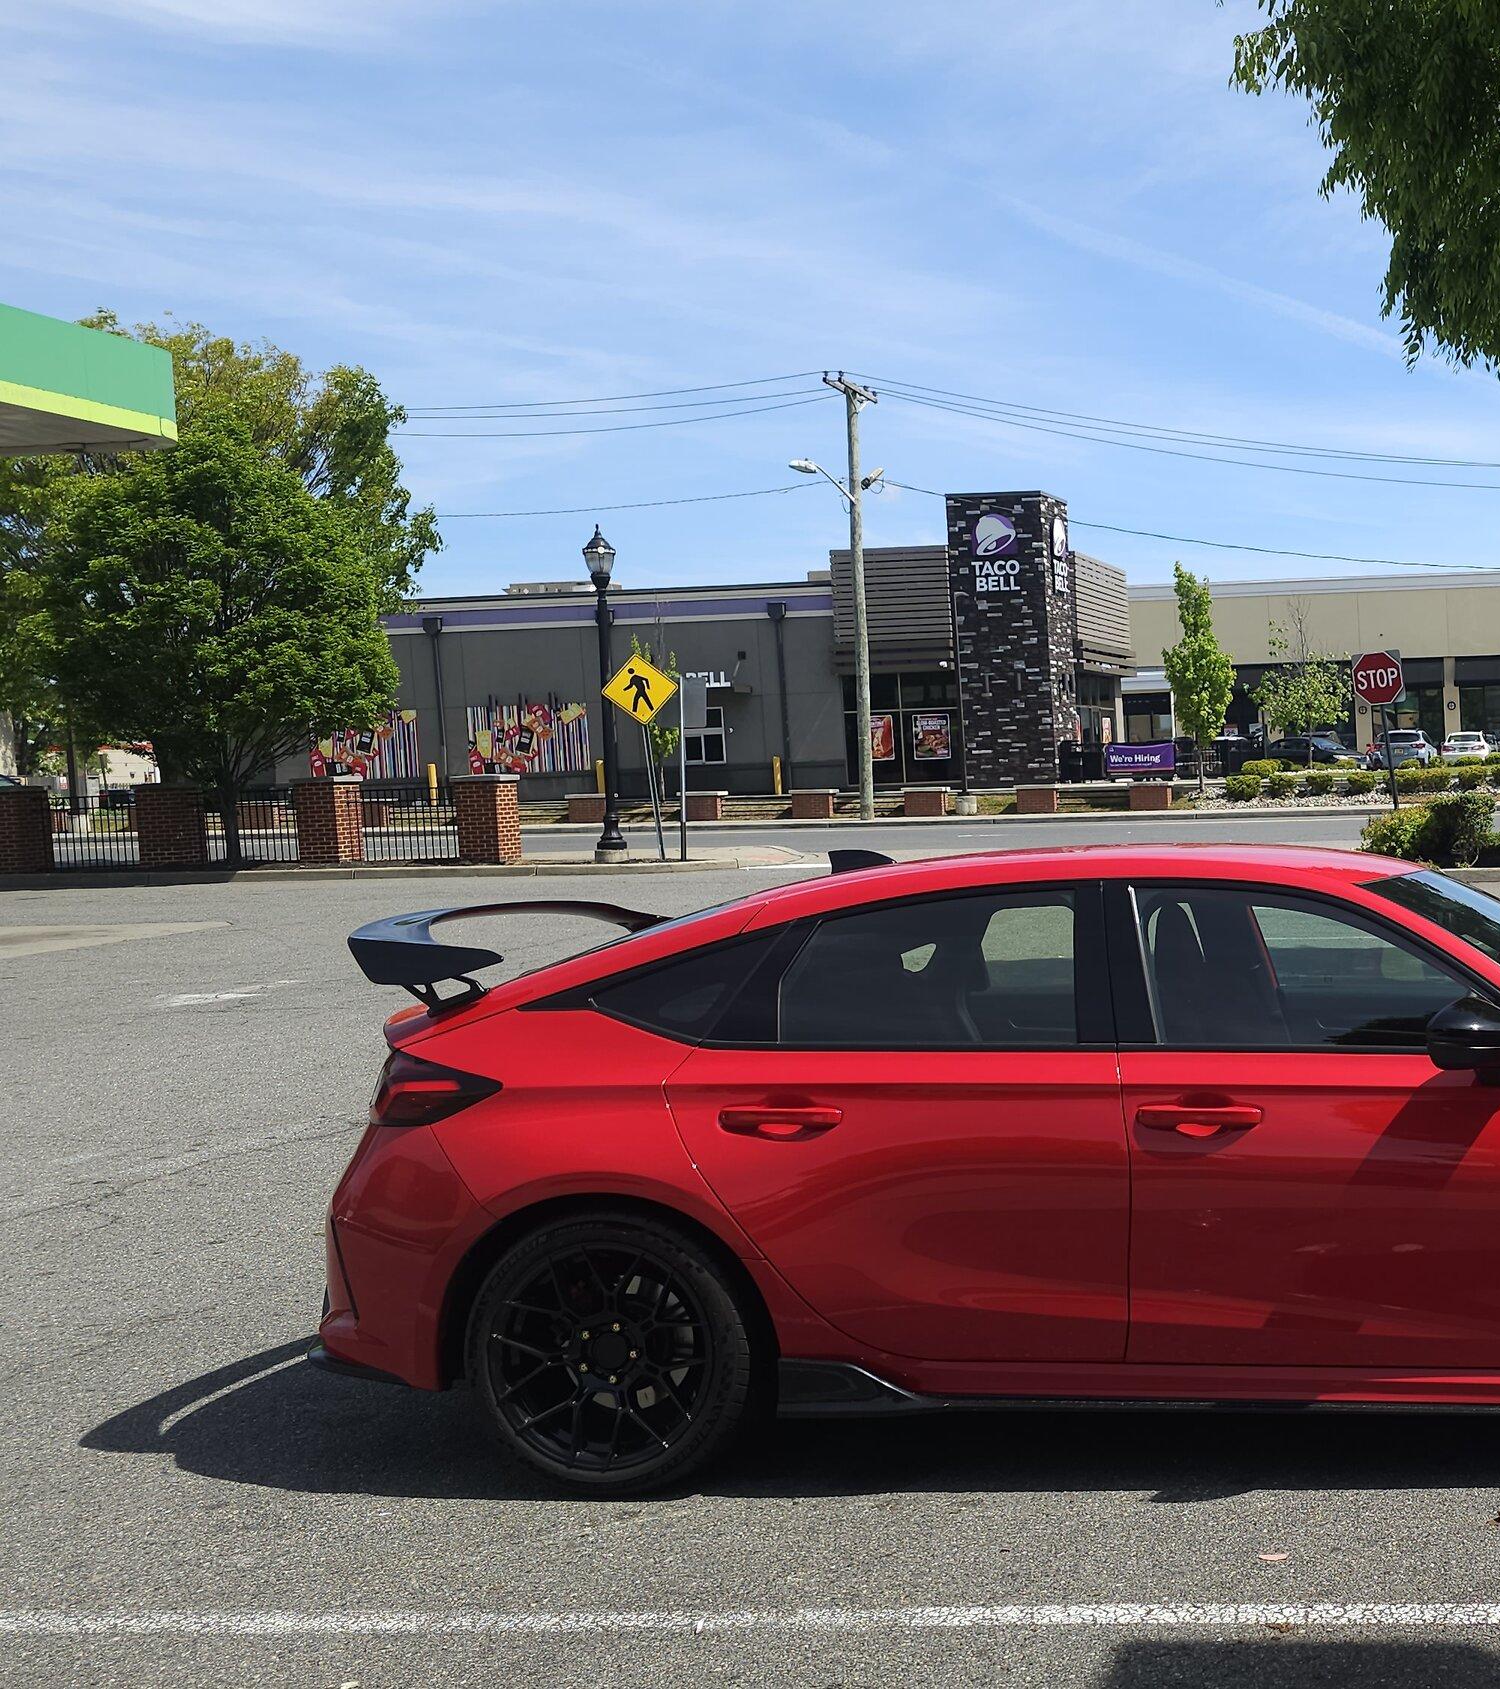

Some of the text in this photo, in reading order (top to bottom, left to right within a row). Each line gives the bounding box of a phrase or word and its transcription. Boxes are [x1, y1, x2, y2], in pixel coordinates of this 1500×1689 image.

[971, 559, 1020, 576] TACO
[1053, 559, 1067, 577] TACO
[976, 577, 1021, 592] BELL
[1055, 575, 1070, 592] BELL
[1357, 667, 1398, 690] STOP
[1110, 753, 1161, 763] We're Hiring
